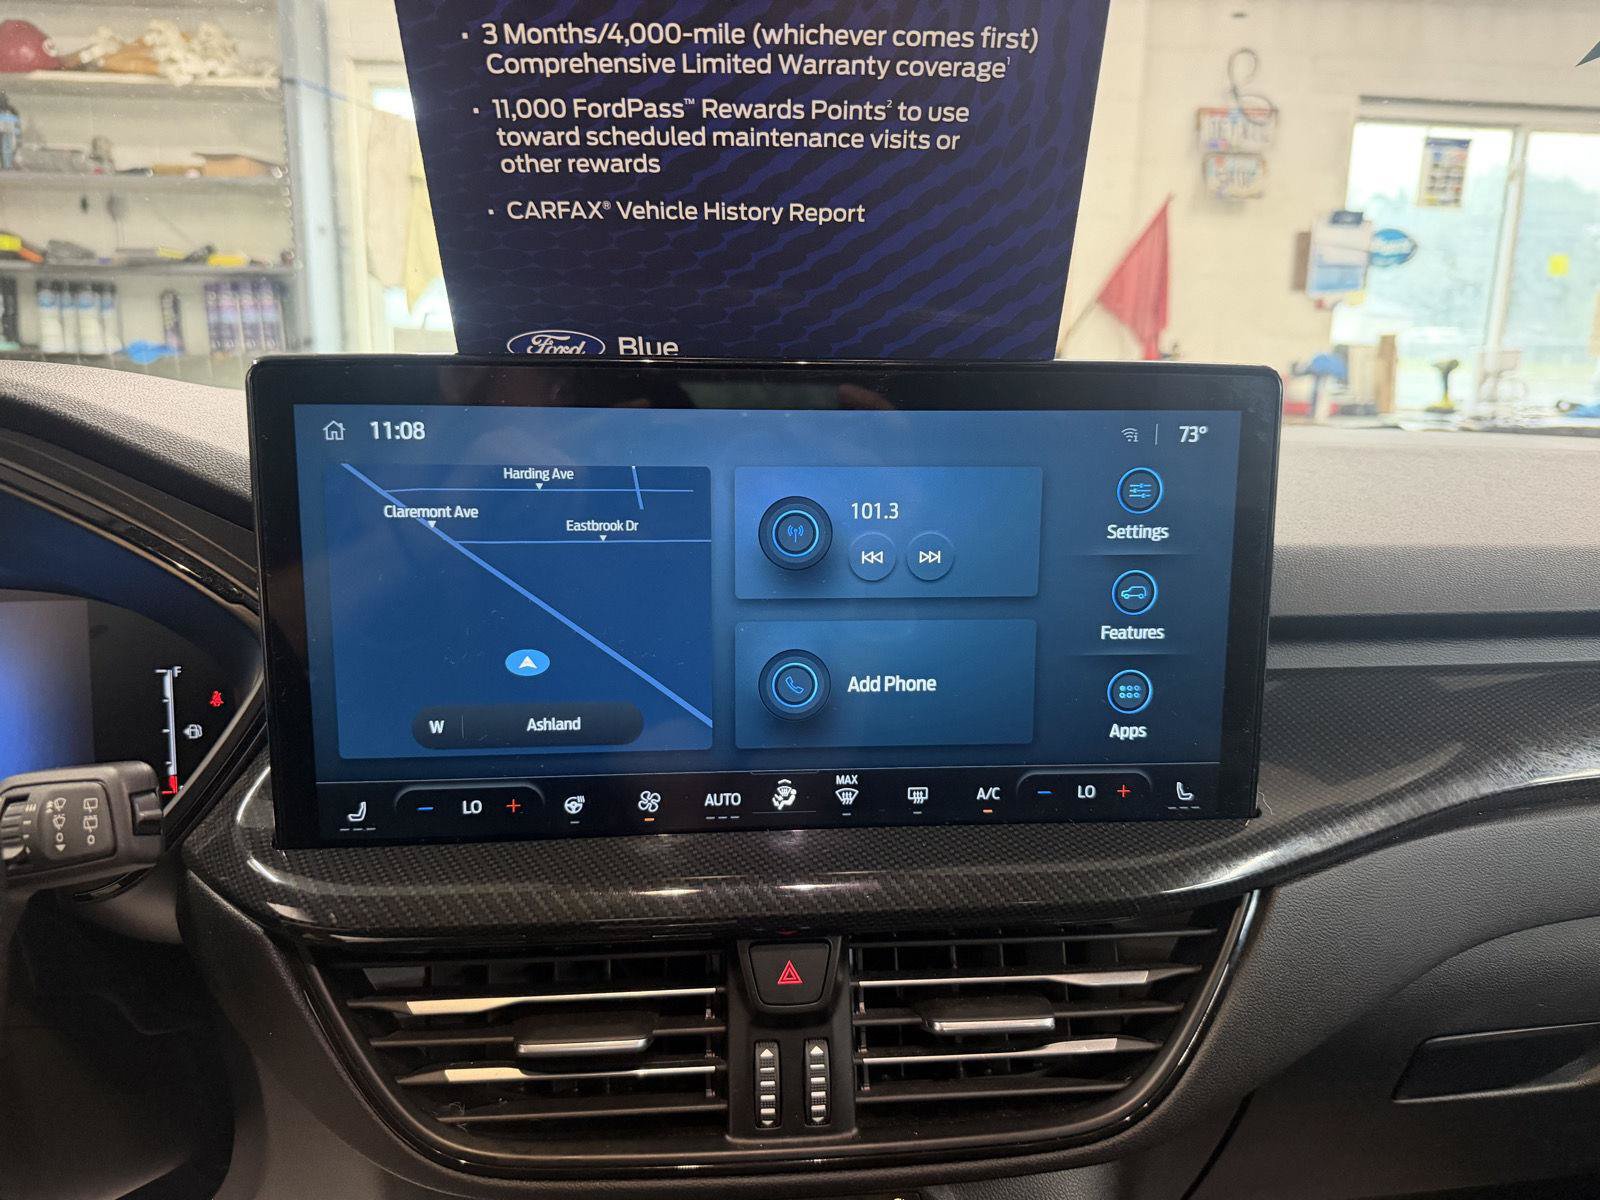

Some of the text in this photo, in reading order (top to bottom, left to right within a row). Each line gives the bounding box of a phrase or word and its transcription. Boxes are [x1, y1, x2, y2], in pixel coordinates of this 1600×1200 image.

[482, 22, 1040, 54] 3 Months/4,000-mile (whichever comes first)
[486, 52, 676, 78] Comprehensive
[681, 53, 773, 76] Limited
[779, 54, 890, 81] Warranty
[491, 98, 568, 121] 11,000
[701, 100, 806, 122] Rewards
[897, 103, 923, 123] to
[926, 105, 970, 124] use
[496, 126, 961, 151] toward scheduled maintenance visits or
[499, 153, 662, 176] other rewards
[615, 201, 699, 223] Vehicle
[702, 201, 785, 226] History
[788, 203, 867, 226] Report
[618, 336, 679, 355] Blue
[369, 421, 426, 441] 11:08
[503, 467, 575, 481] Harding Ave
[383, 505, 480, 520] Claremont Ave
[850, 501, 900, 520] 101.3
[565, 519, 640, 533] Eastbrook Dr
[1106, 524, 1170, 541] Settings
[1100, 625, 1165, 641] Features
[847, 676, 938, 693] Add Phone
[429, 720, 445, 734] W
[526, 717, 582, 732] Ashland
[1109, 724, 1147, 740] Apps
[835, 775, 859, 786] MAX
[704, 793, 742, 807] AUTO
[976, 787, 1001, 801] A/C
[1077, 785, 1096, 799] LO
[462, 801, 483, 815] LO
